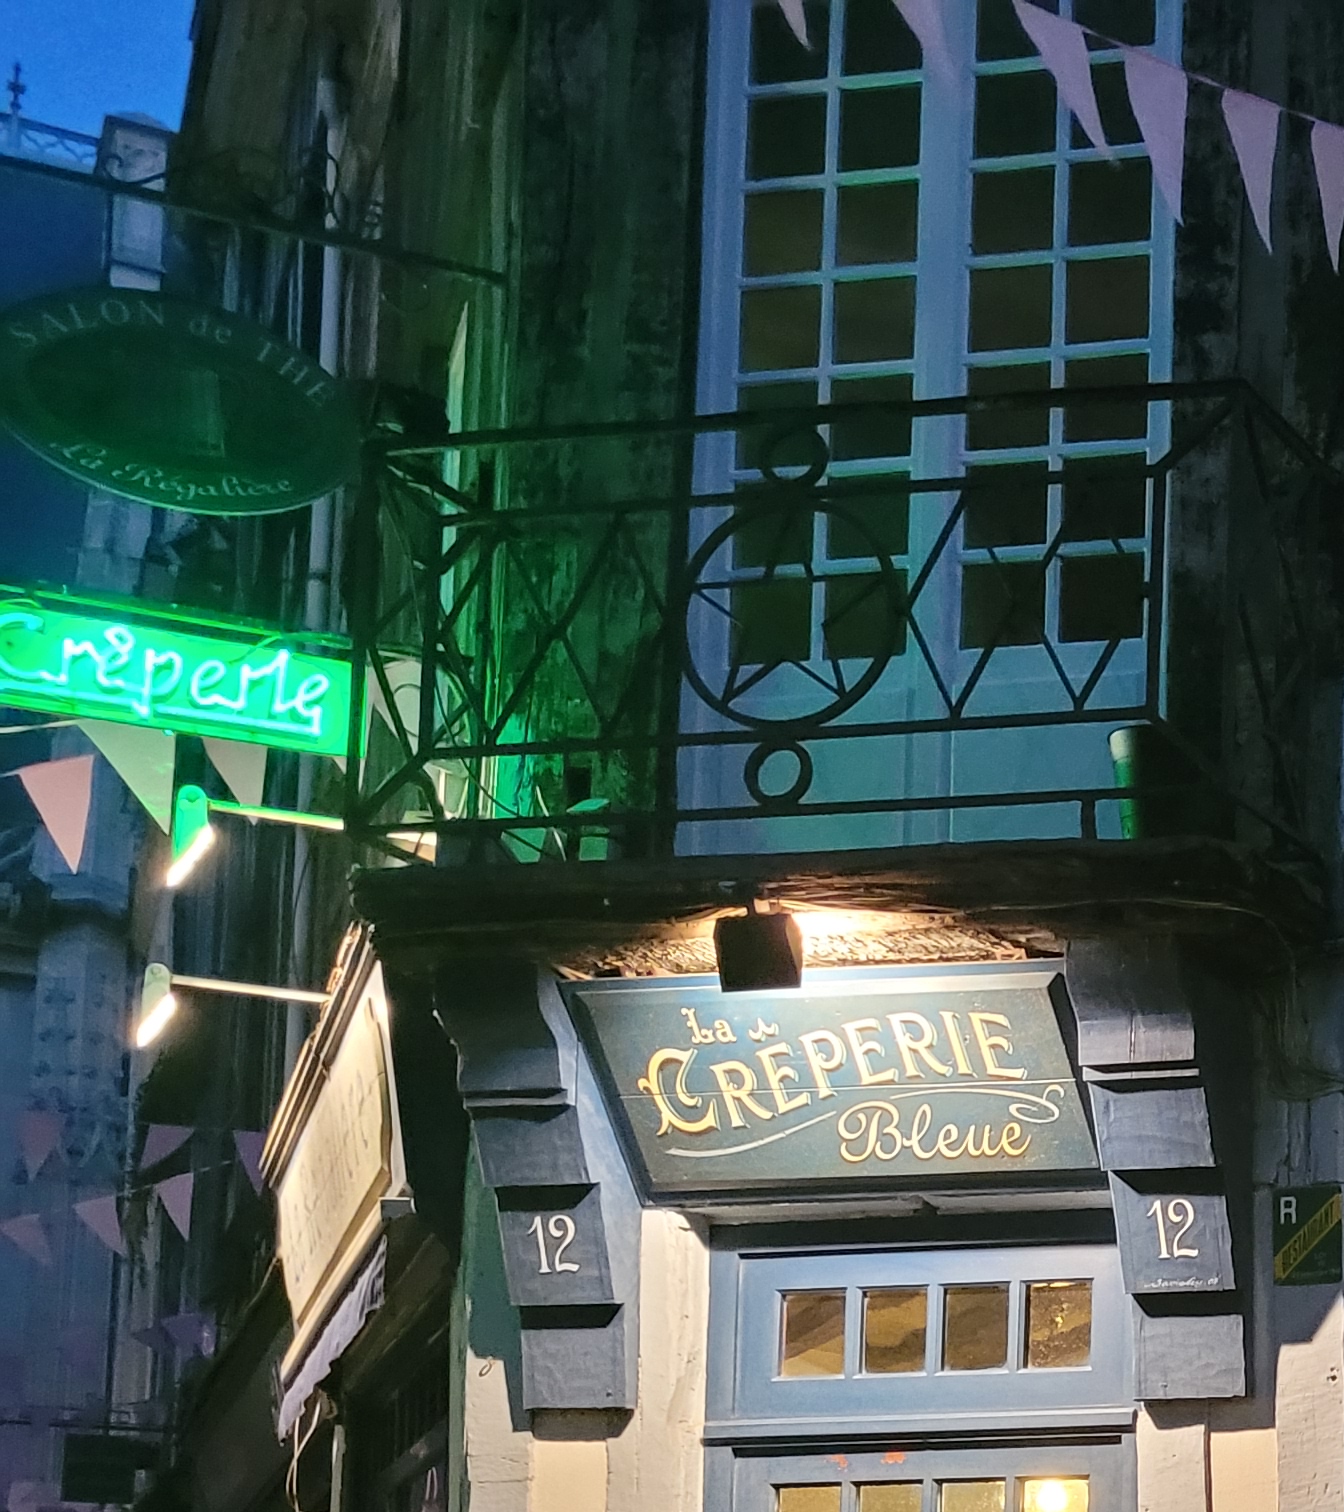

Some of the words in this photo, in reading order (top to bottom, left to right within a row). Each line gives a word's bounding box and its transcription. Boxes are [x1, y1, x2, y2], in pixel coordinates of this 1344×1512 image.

[9, 298, 166, 349] SALON
[189, 310, 232, 345] de
[49, 441, 107, 470] La
[681, 1008, 738, 1043] La
[837, 1101, 1032, 1163] Bleue
[1147, 1198, 1199, 1260] 12
[1279, 1196, 1297, 1225] R
[528, 1214, 581, 1275] 12
